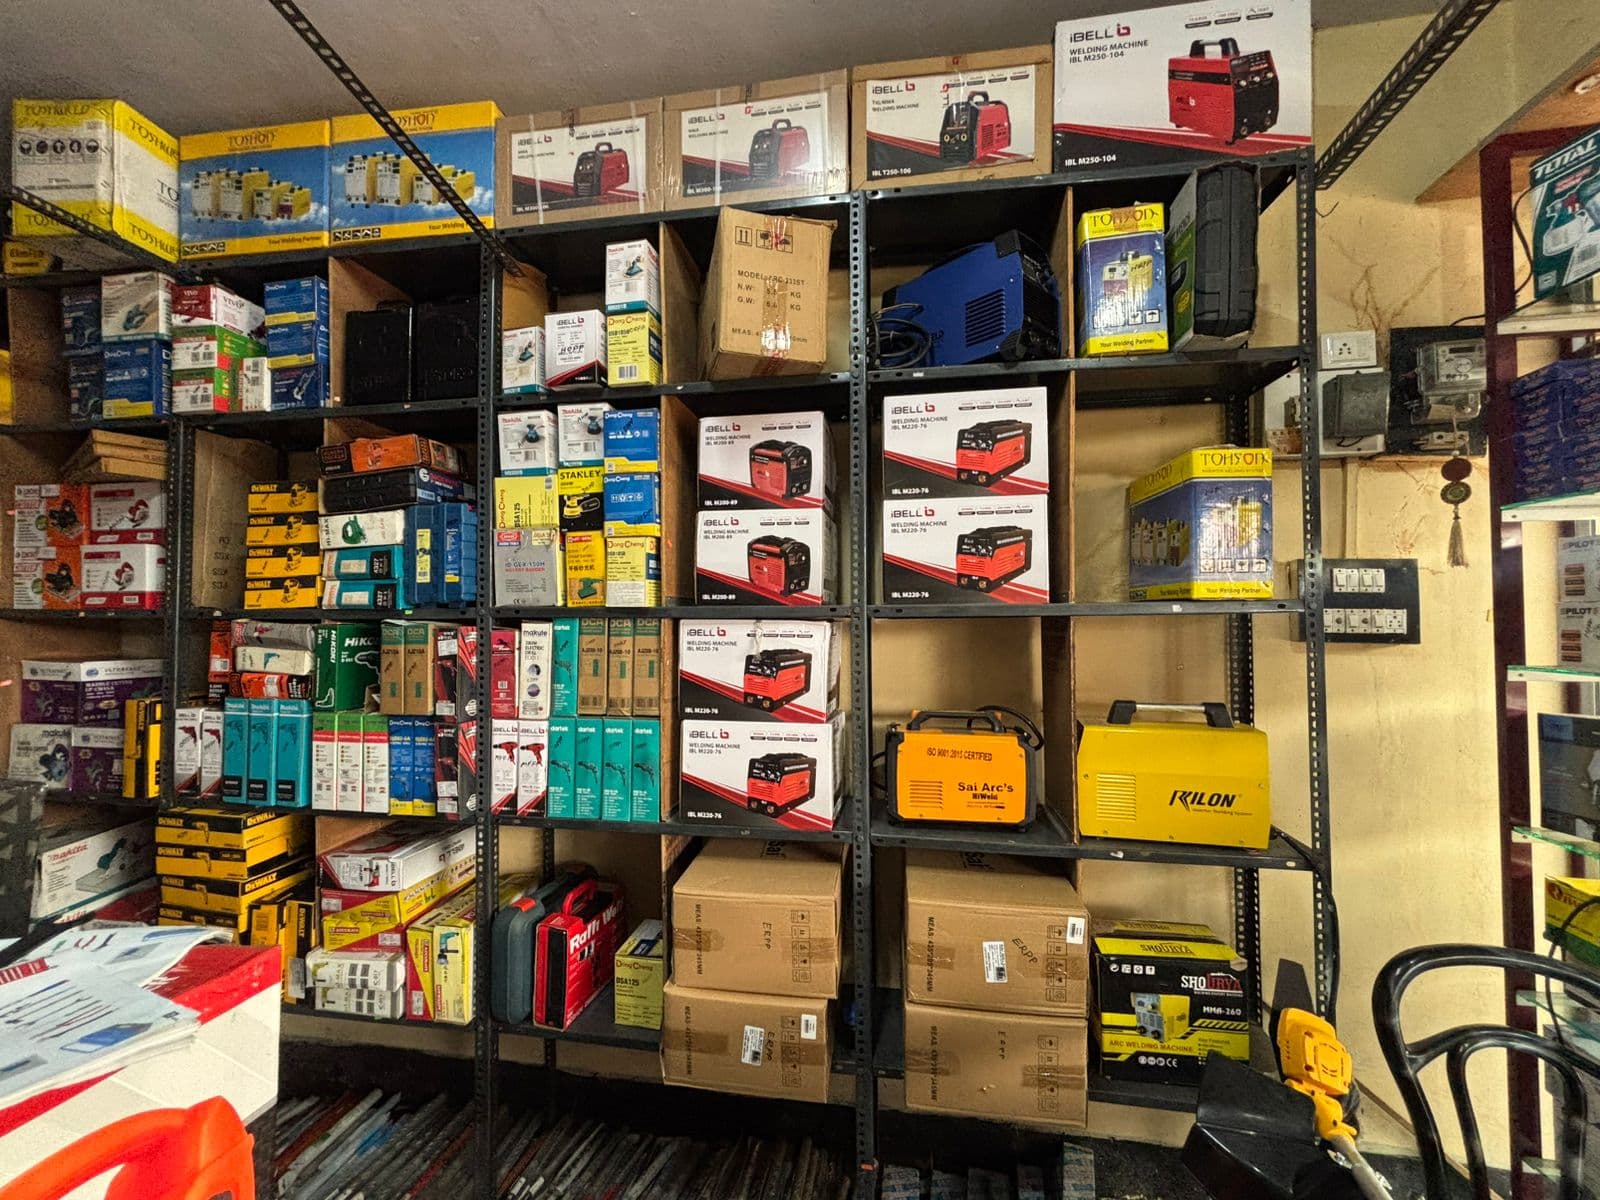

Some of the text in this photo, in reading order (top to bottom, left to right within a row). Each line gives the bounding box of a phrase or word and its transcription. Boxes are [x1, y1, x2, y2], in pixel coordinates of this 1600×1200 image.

[1069, 30, 1114, 43] iBELL
[1069, 39, 1149, 56] WELDING MACHINE
[1069, 50, 1125, 64] IBL M250-104
[872, 85, 904, 94] iBELL
[1065, 154, 1117, 166] IBL M250-104
[790, 291, 802, 299] KG
[891, 406, 922, 414] iBELL
[560, 470, 600, 479] STANLEY
[1568, 540, 1594, 549] PILOT
[1565, 607, 1592, 615] PILOT
[687, 629, 715, 637] iBELL
[689, 731, 718, 739] iBELL
[927, 748, 936, 756] ISO
[964, 751, 992, 761] CERTIFIED
[958, 782, 1014, 792] Sai Arc's
[1181, 972, 1243, 991] SHOURYA
[1126, 1041, 1159, 1049] WELDING
[1160, 1044, 1194, 1052] MACHINE
